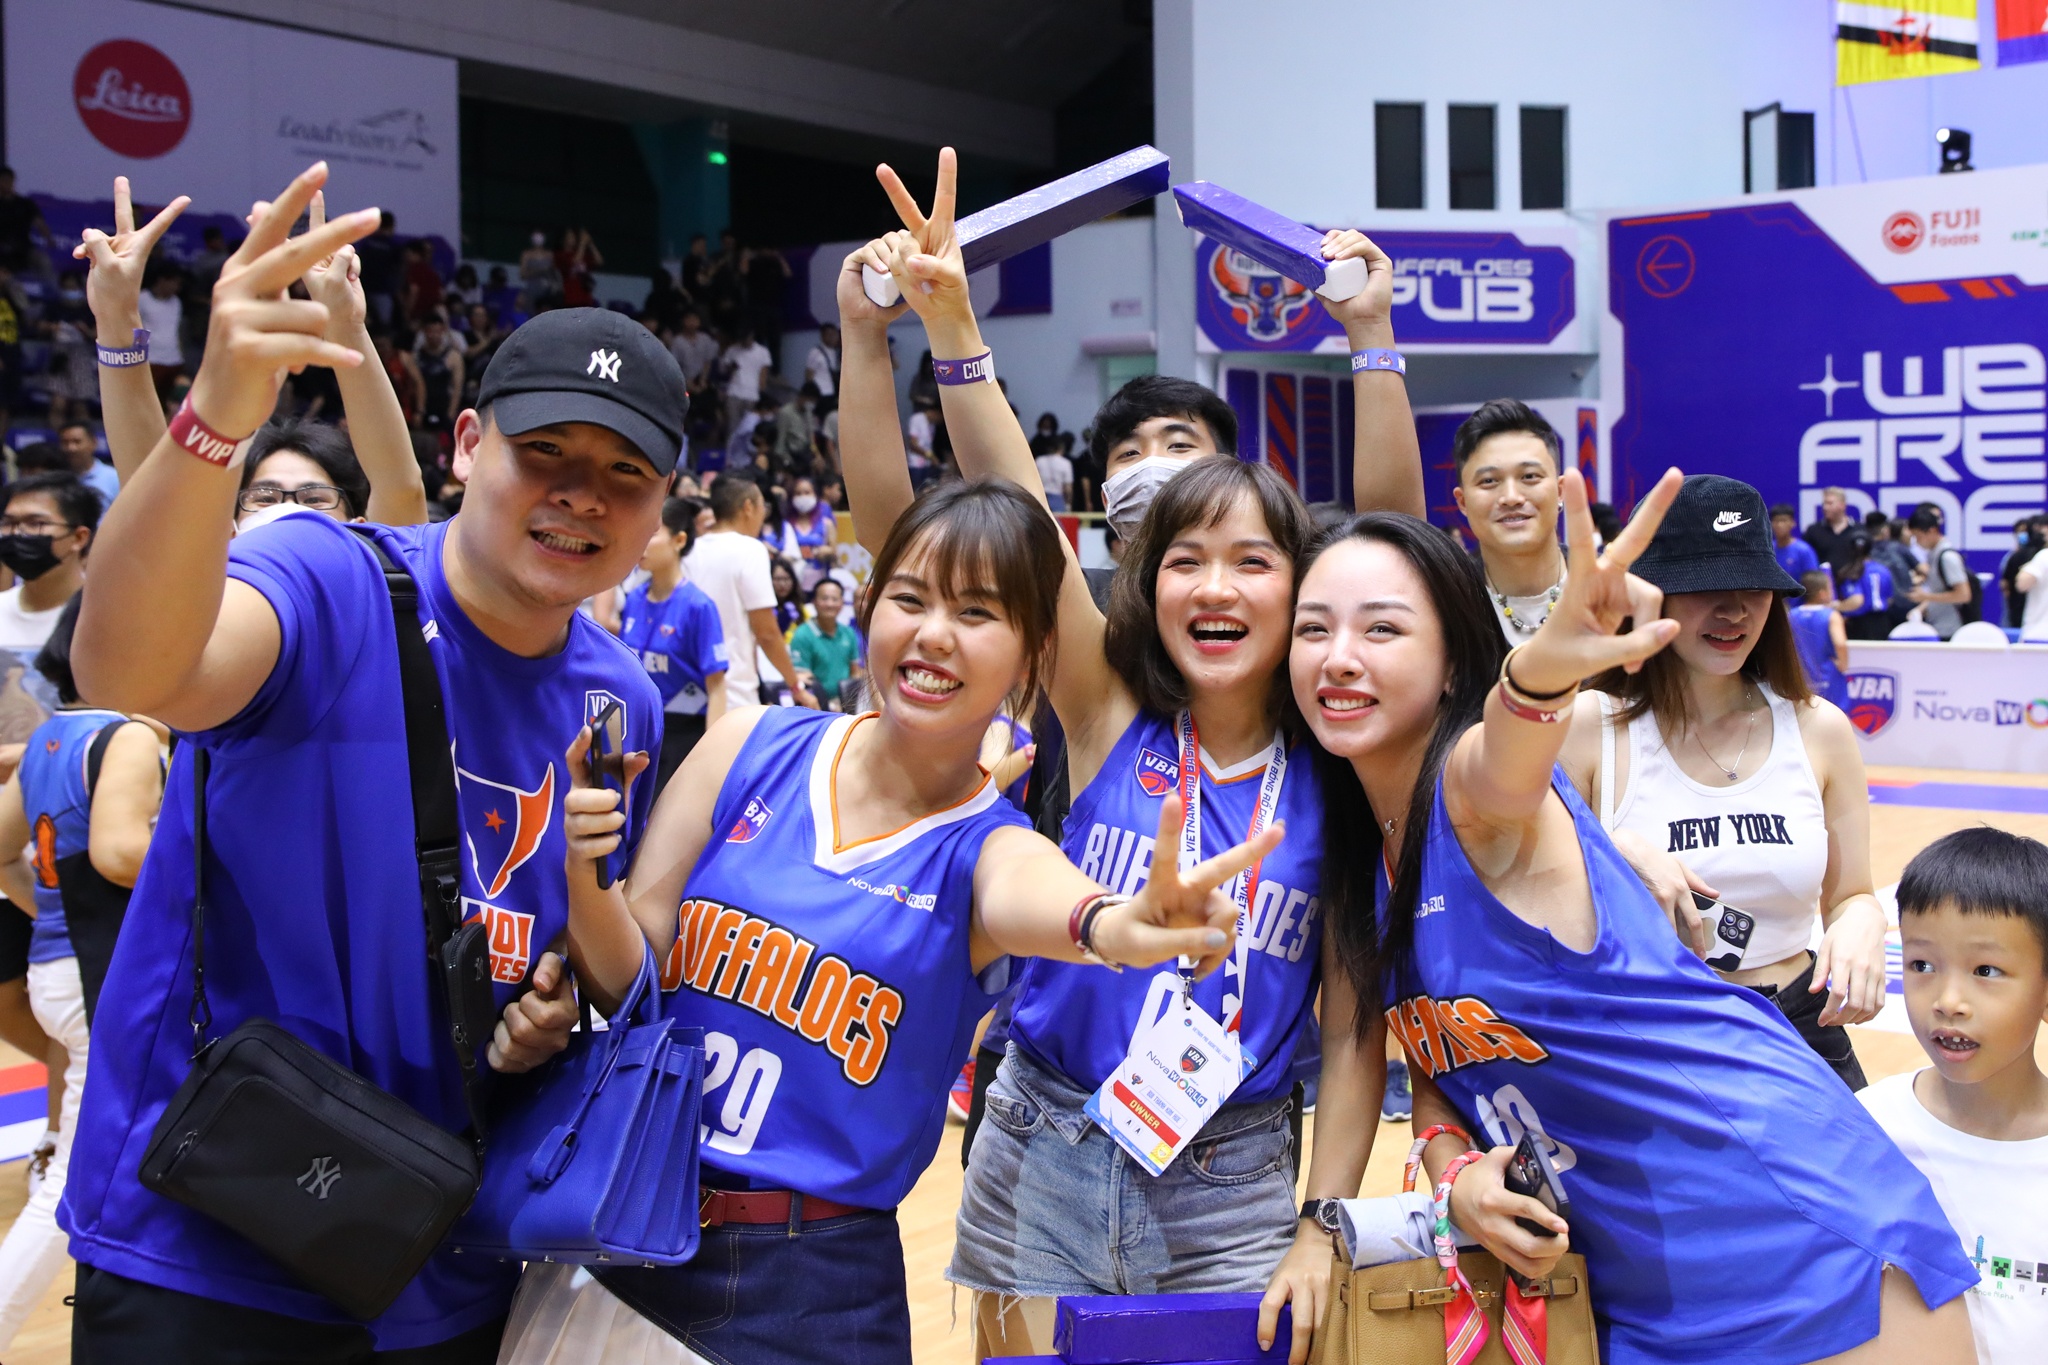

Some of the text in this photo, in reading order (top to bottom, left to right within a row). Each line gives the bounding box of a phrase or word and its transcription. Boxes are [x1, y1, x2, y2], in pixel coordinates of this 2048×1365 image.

[79, 67, 183, 122] Leica
[1930, 208, 1981, 229] FUJI
[1930, 233, 1980, 248] Foods
[1392, 258, 1534, 276] UFFALOES
[98, 349, 146, 366] PREMIUM
[185, 424, 236, 462] VVIP
[1798, 412, 2047, 486] ARE
[1718, 510, 1742, 524] NIKE
[1846, 676, 1895, 701] VBA
[1144, 756, 1179, 779] VBA
[1186, 776, 1196, 800] PRO
[744, 800, 768, 828] BA
[1186, 801, 1196, 853] VIETNAM
[1667, 813, 1794, 853] NEW YORK
[660, 899, 904, 1086] BUFFALOES
[1186, 1048, 1205, 1067] VBA
[1144, 1049, 1208, 1108] NovaWORLD
[701, 1031, 783, 1156] 29
[1128, 1098, 1162, 1130] OWNER
